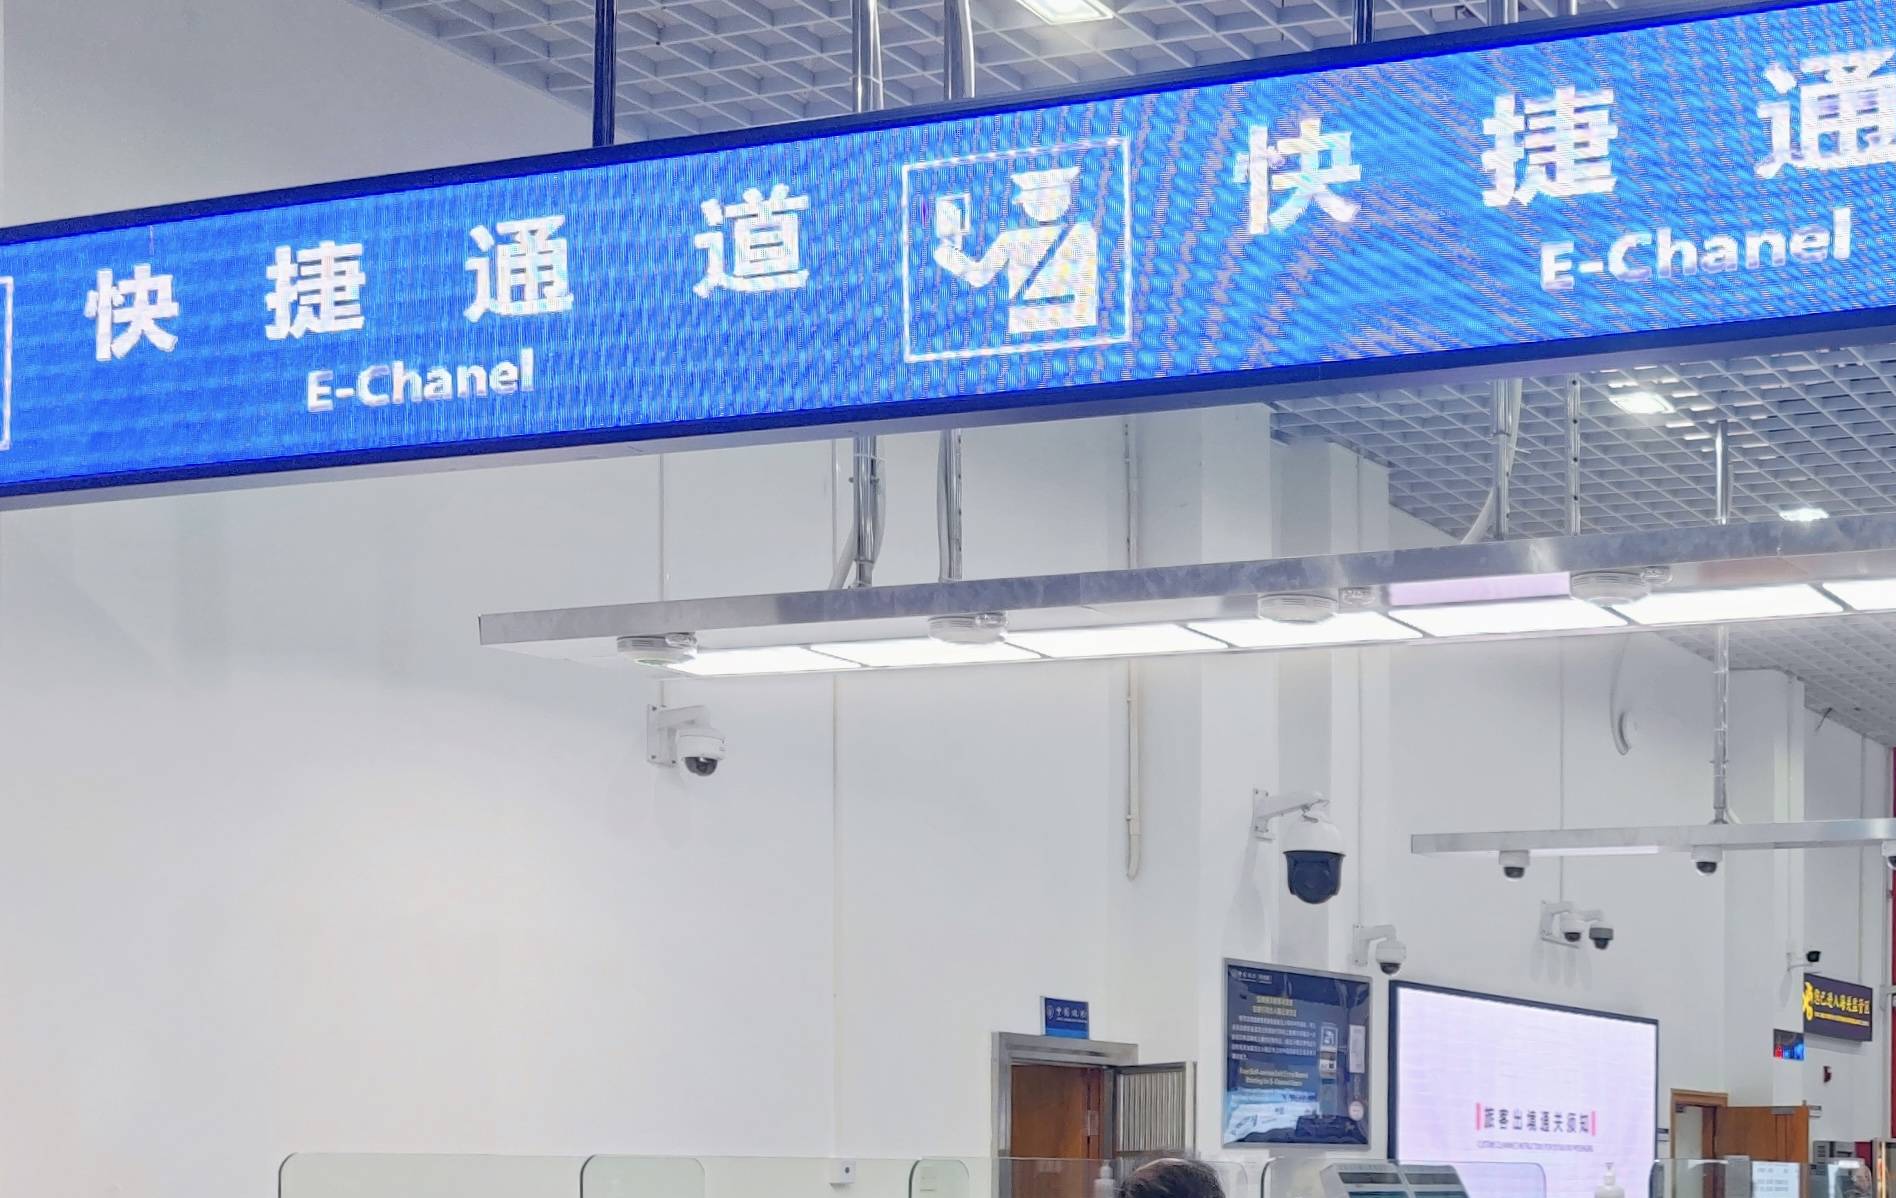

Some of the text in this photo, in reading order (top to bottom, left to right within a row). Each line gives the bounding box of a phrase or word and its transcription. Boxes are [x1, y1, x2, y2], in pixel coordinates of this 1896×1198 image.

[84, 182, 809, 361] 快捷通道
[1540, 207, 1851, 292] E-Chanel
[306, 348, 535, 413] E-Chanel
